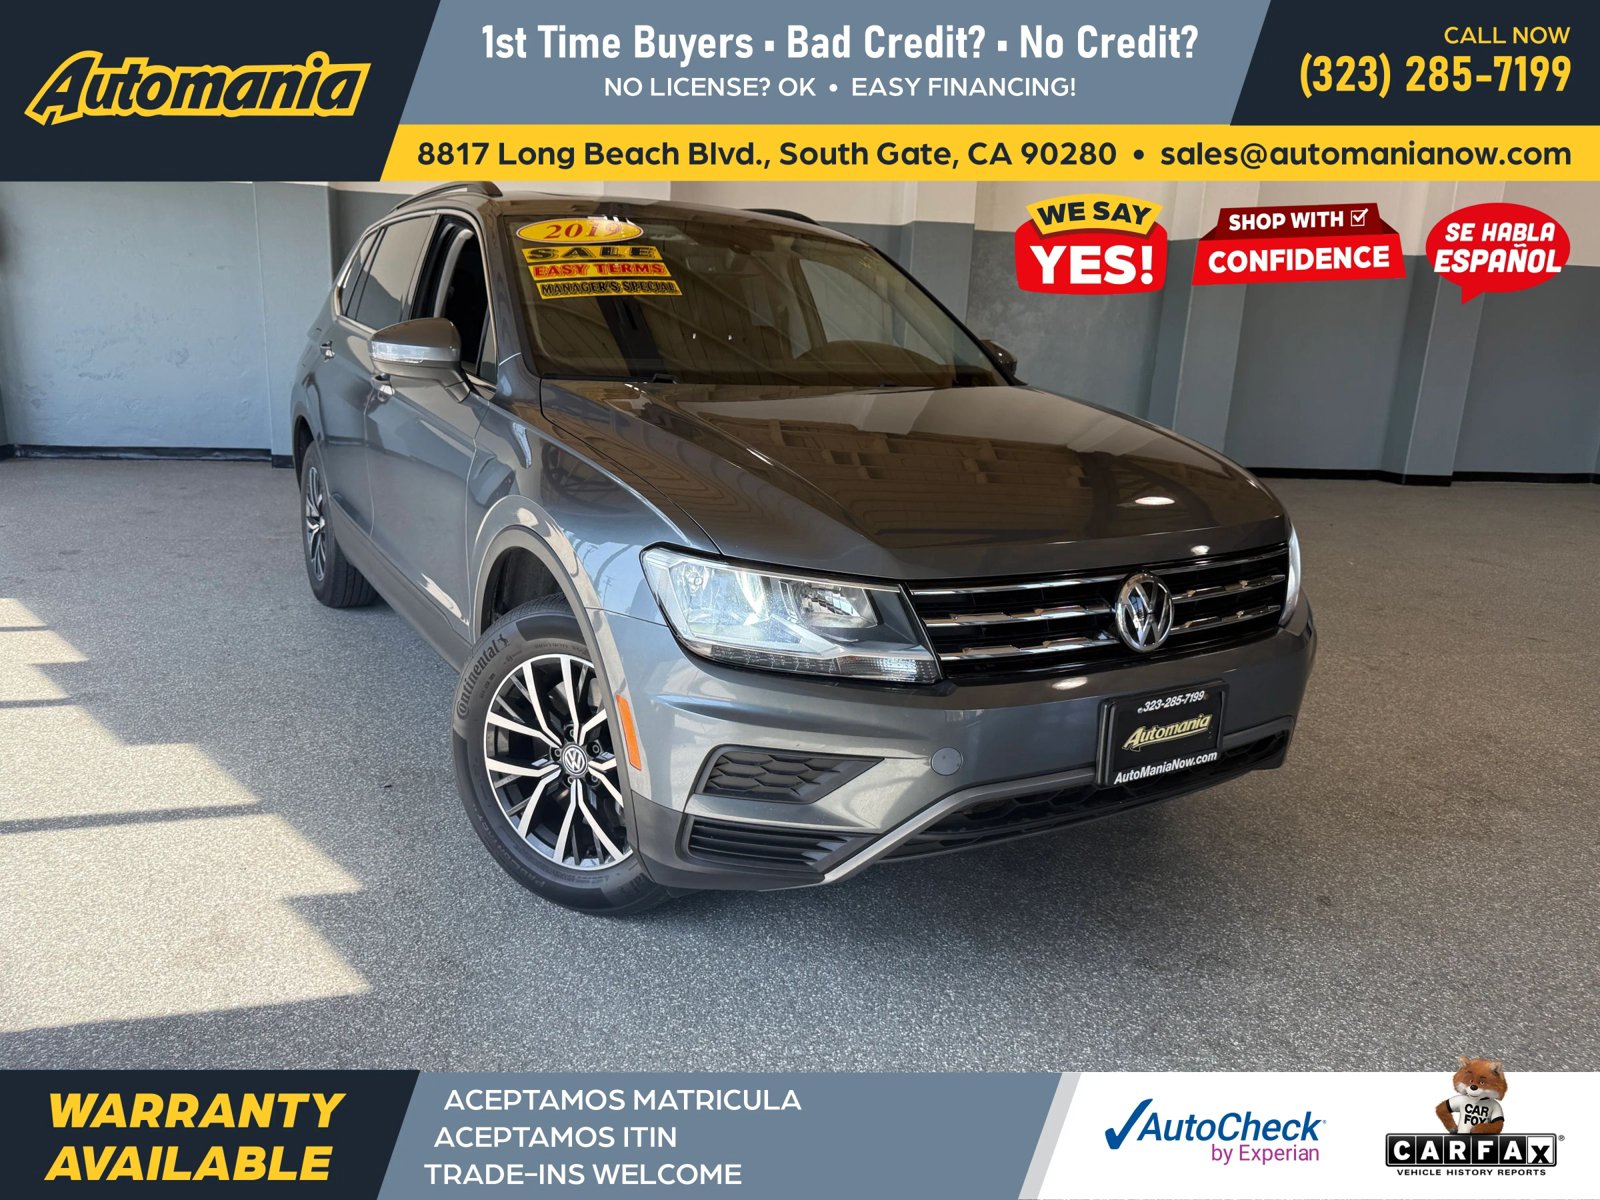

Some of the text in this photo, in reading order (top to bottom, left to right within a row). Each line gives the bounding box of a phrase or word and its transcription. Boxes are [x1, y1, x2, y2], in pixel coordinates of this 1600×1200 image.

[544, 222, 623, 240] 2019
[527, 246, 656, 260] SALE
[534, 263, 667, 277] EASY TERMS
[541, 280, 679, 296] MANAGER'S SPECIAL
[456, 639, 501, 720] Continental
[1143, 690, 1206, 713] 323-285-7199
[1122, 713, 1213, 752] Automania
[1114, 751, 1218, 785] AutoManiaNow.com
